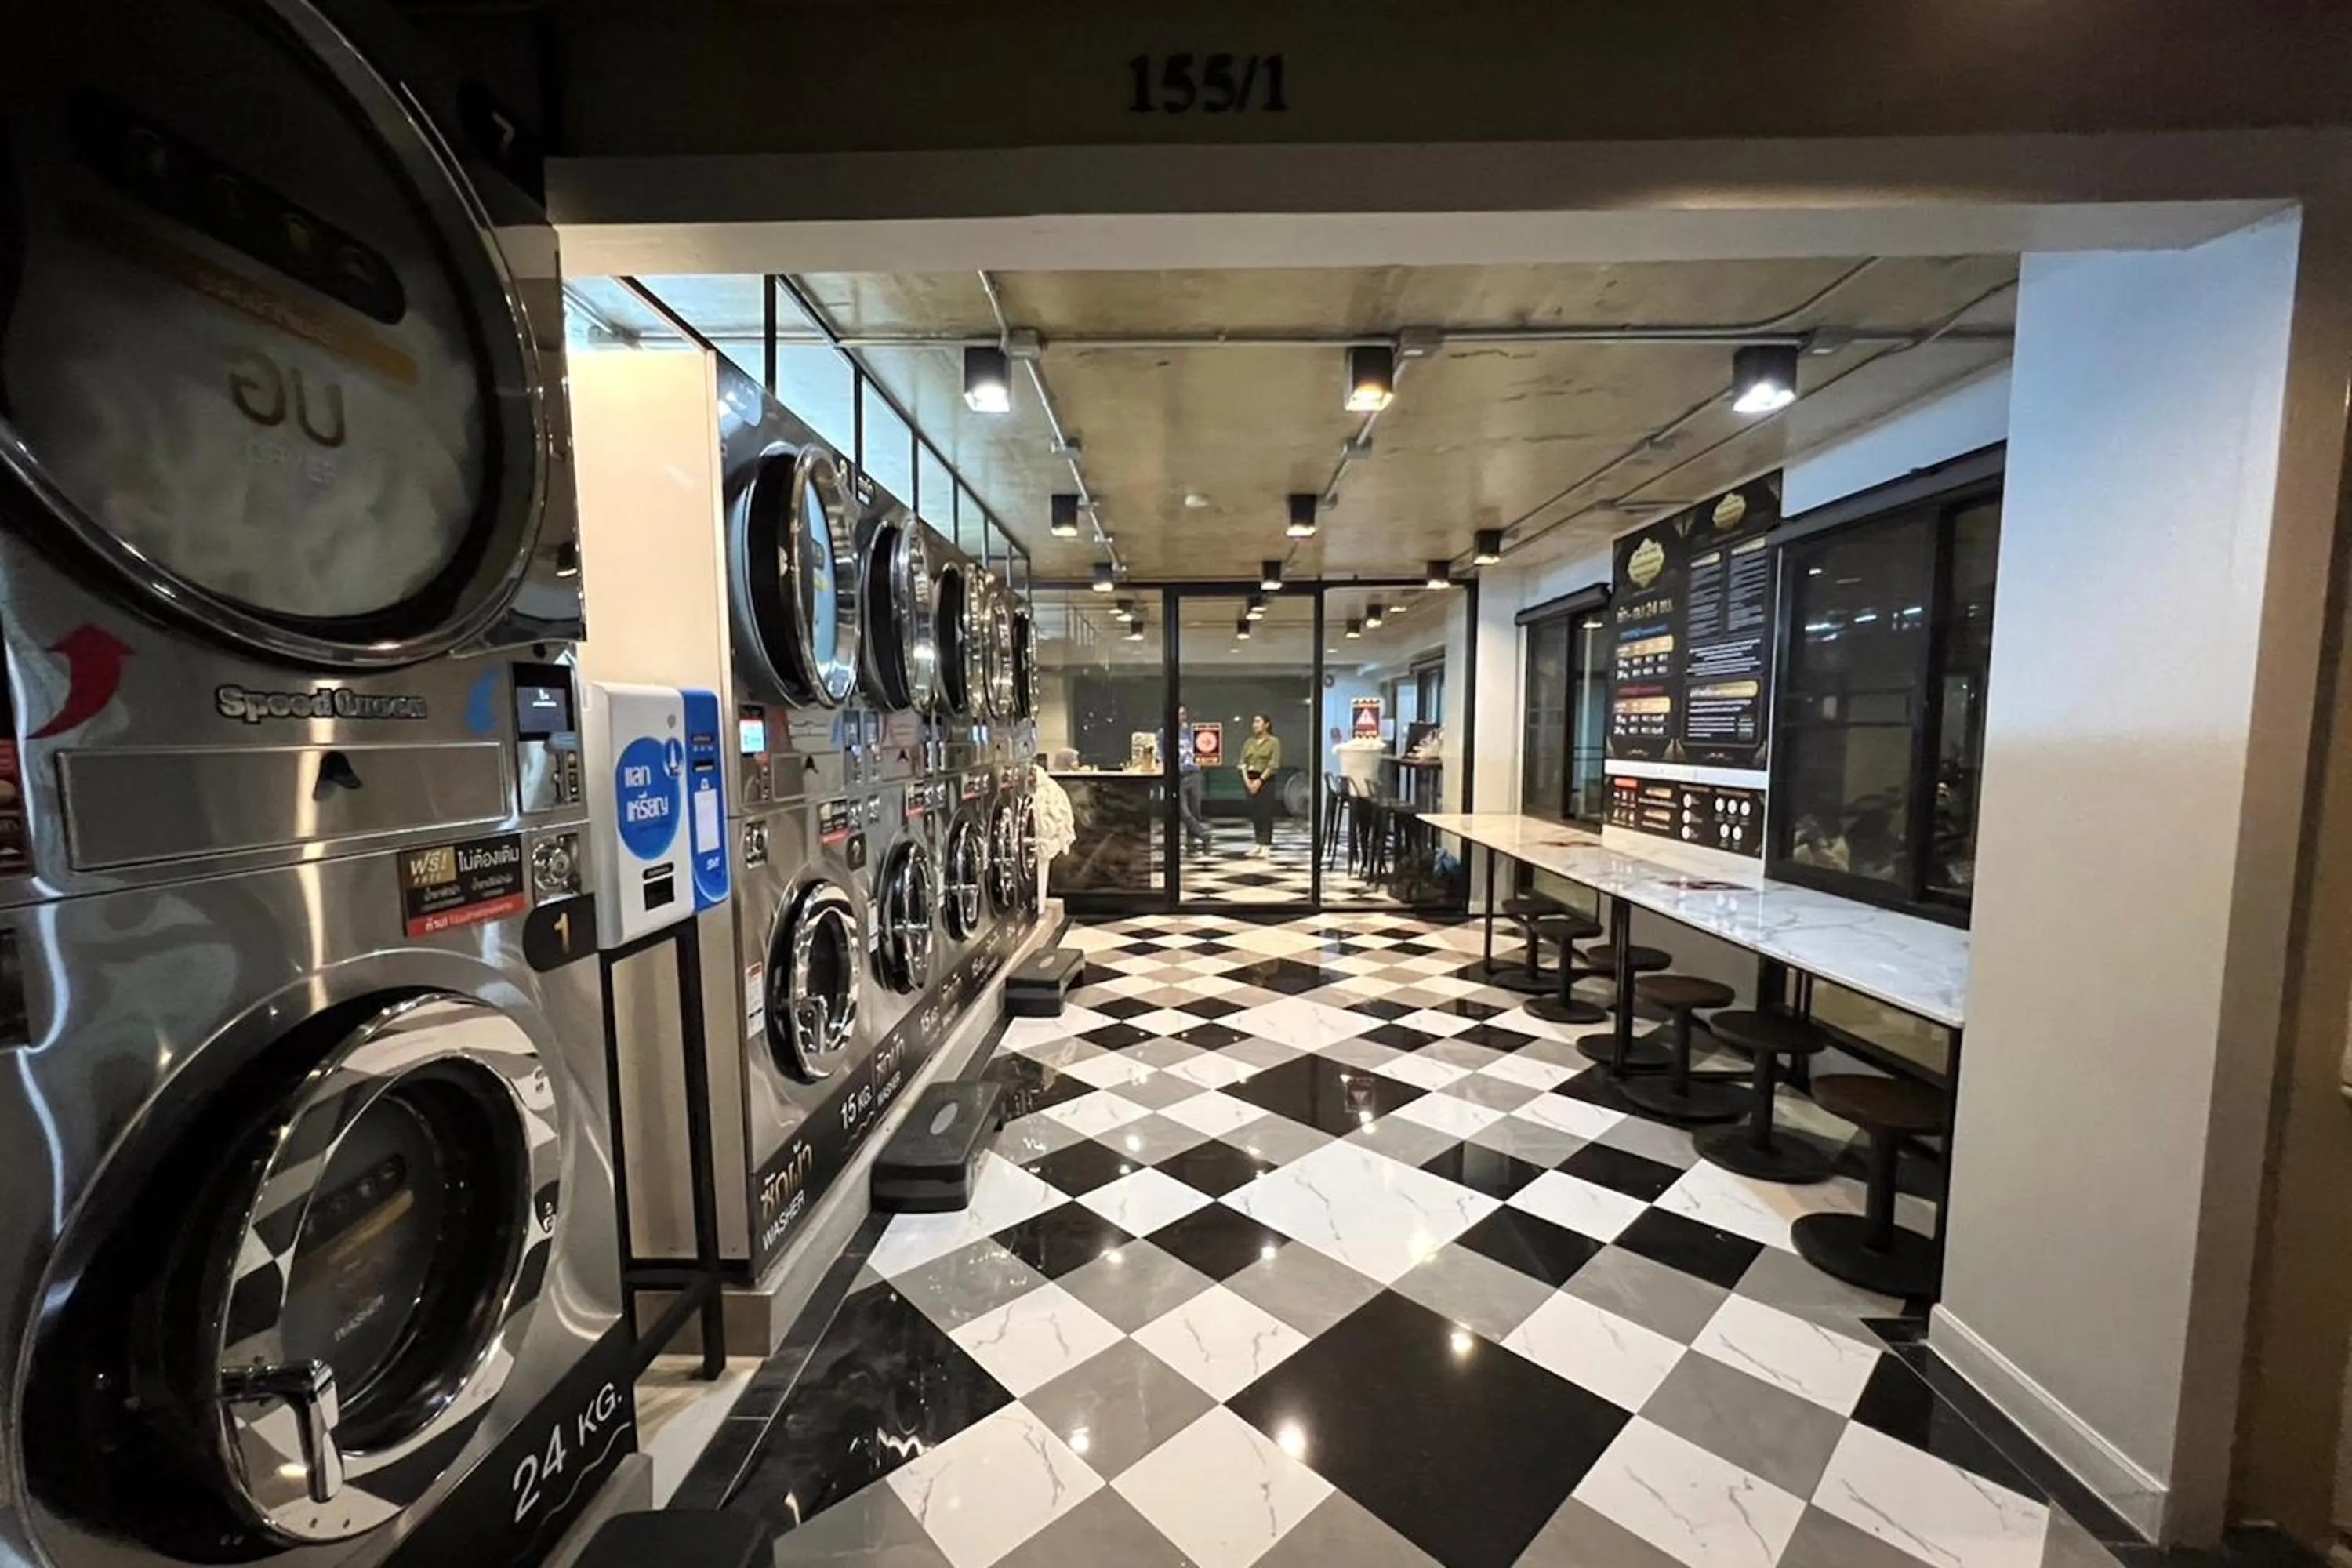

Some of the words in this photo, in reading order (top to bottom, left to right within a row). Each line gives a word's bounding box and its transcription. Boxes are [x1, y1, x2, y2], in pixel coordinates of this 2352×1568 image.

[1127, 53, 1289, 114] 155/1
[215, 684, 334, 725] Speed
[333, 688, 428, 719] Queen
[624, 764, 652, 789] แลก
[626, 792, 670, 822] เหรียญ
[409, 850, 448, 876] ฟรี!
[554, 912, 571, 954] 1
[840, 1092, 857, 1130] 15
[761, 1189, 806, 1252] WASHER
[512, 1423, 568, 1523] 24
[578, 1381, 622, 1447] KG.
